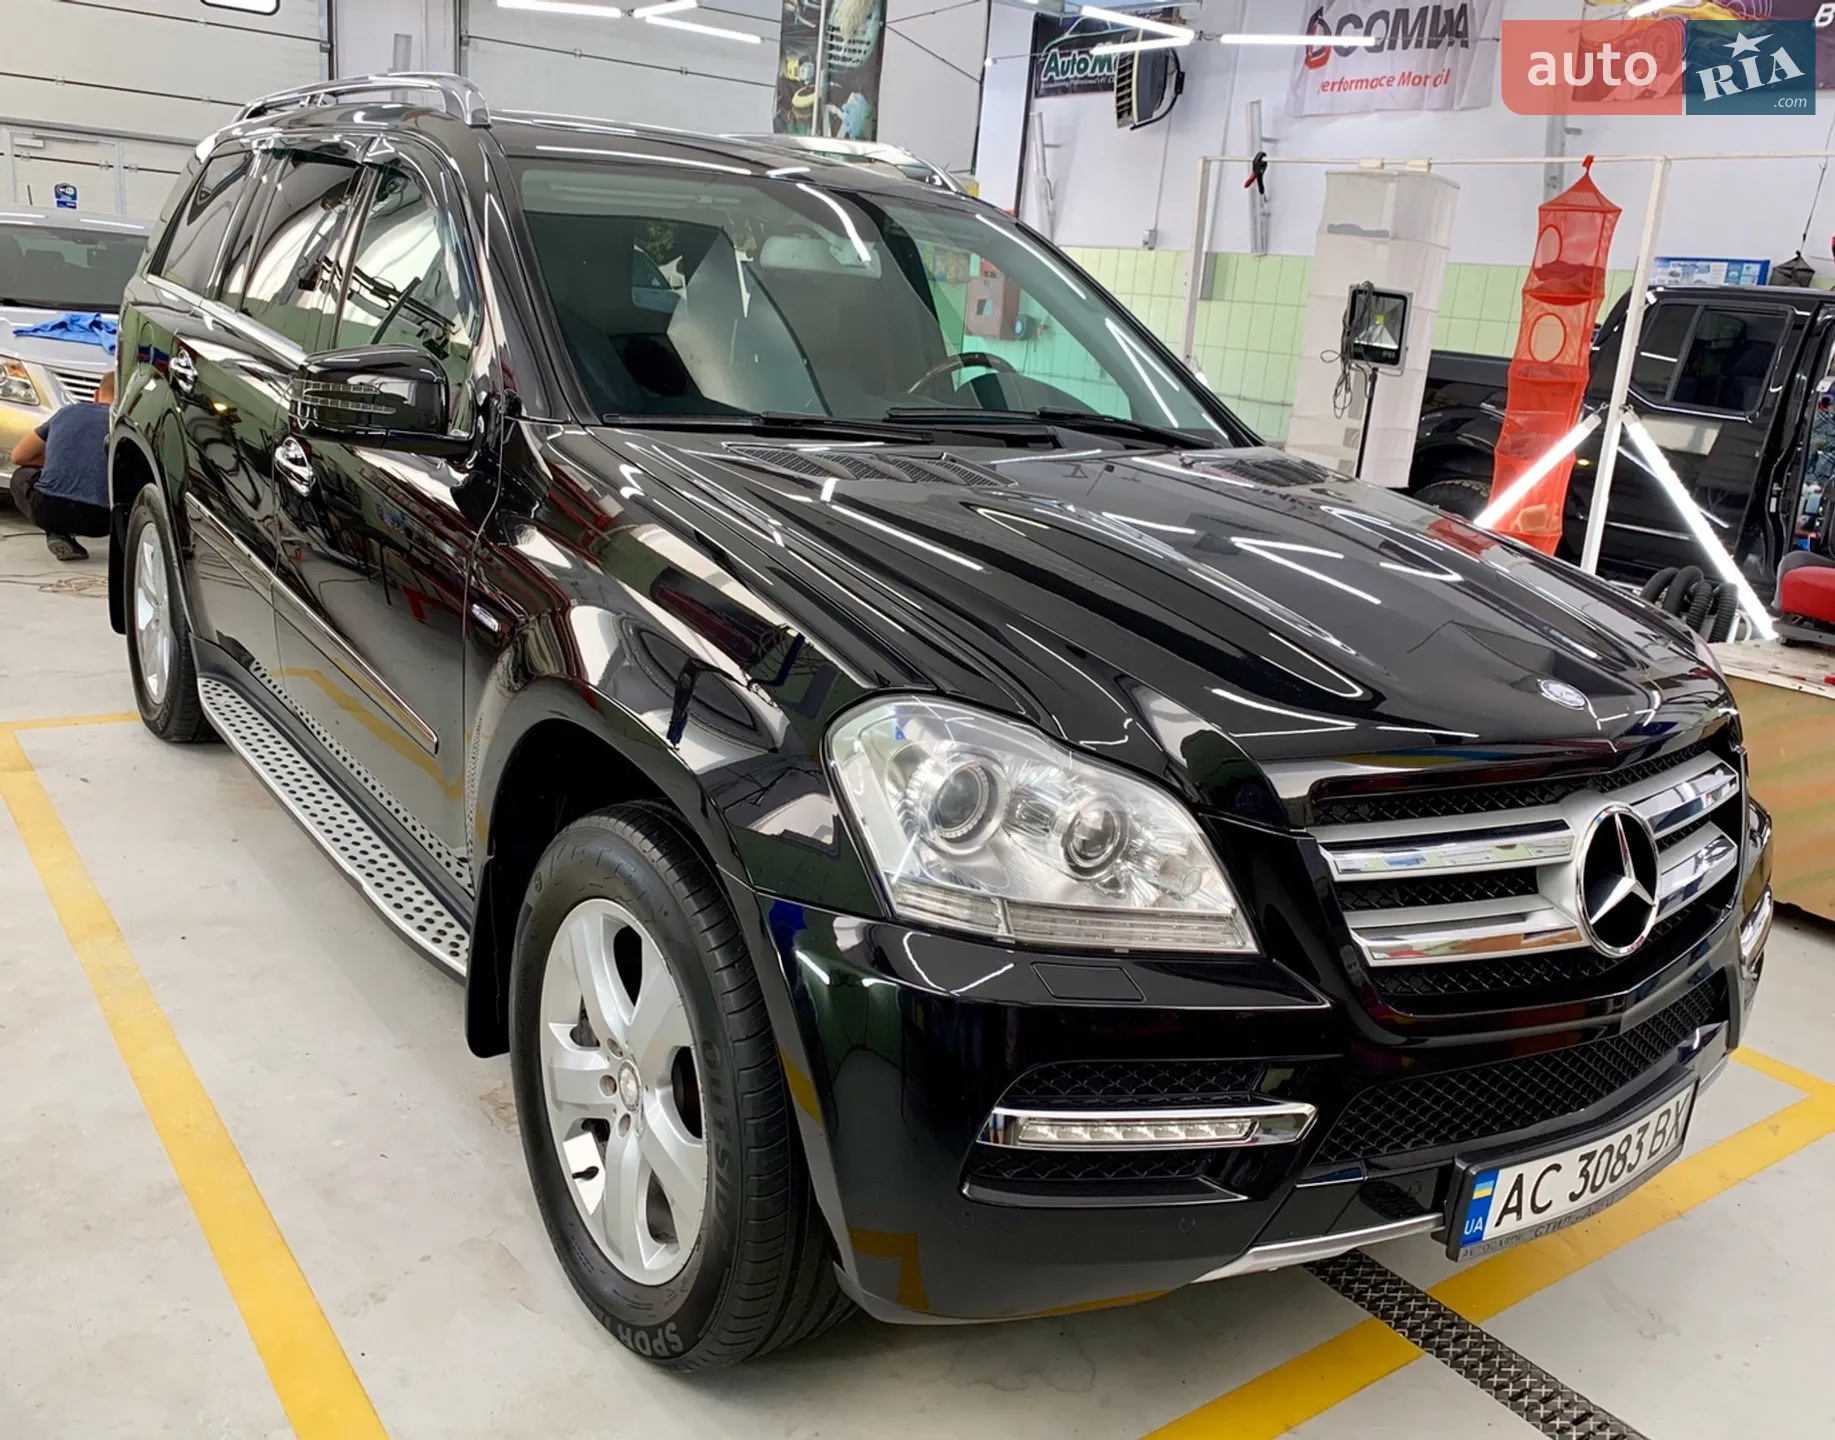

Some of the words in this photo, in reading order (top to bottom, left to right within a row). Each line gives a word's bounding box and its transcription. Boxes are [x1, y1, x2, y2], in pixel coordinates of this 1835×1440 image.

[1495, 1163, 1561, 1228] AC
[1568, 1121, 1650, 1201] 3083
[1647, 1092, 1690, 1160] BX
[1464, 1216, 1484, 1235] UA
